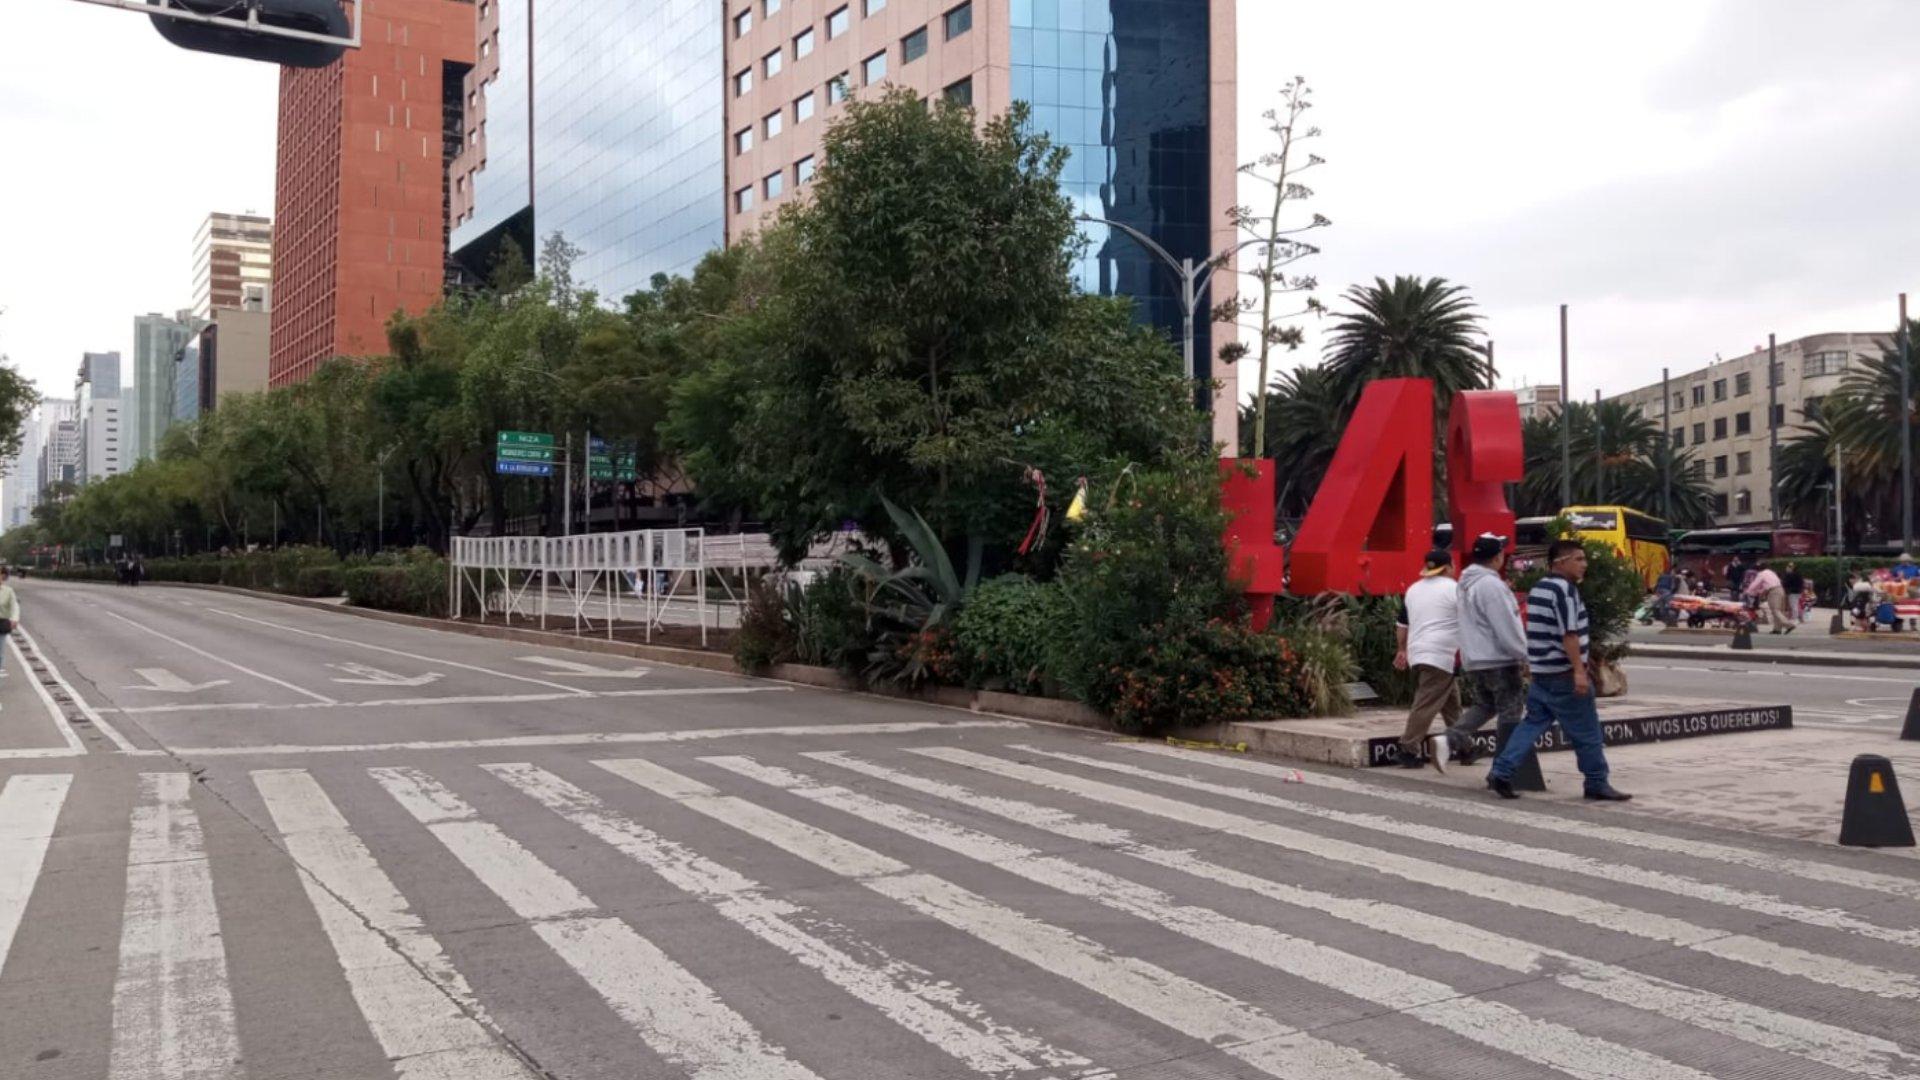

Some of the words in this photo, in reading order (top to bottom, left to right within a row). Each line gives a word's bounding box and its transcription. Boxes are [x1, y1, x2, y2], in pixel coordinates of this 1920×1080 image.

[1641, 718, 1680, 737] VIVOS
[1683, 716, 1707, 733] LOS
[1710, 709, 1780, 729] QUEREMOS!
